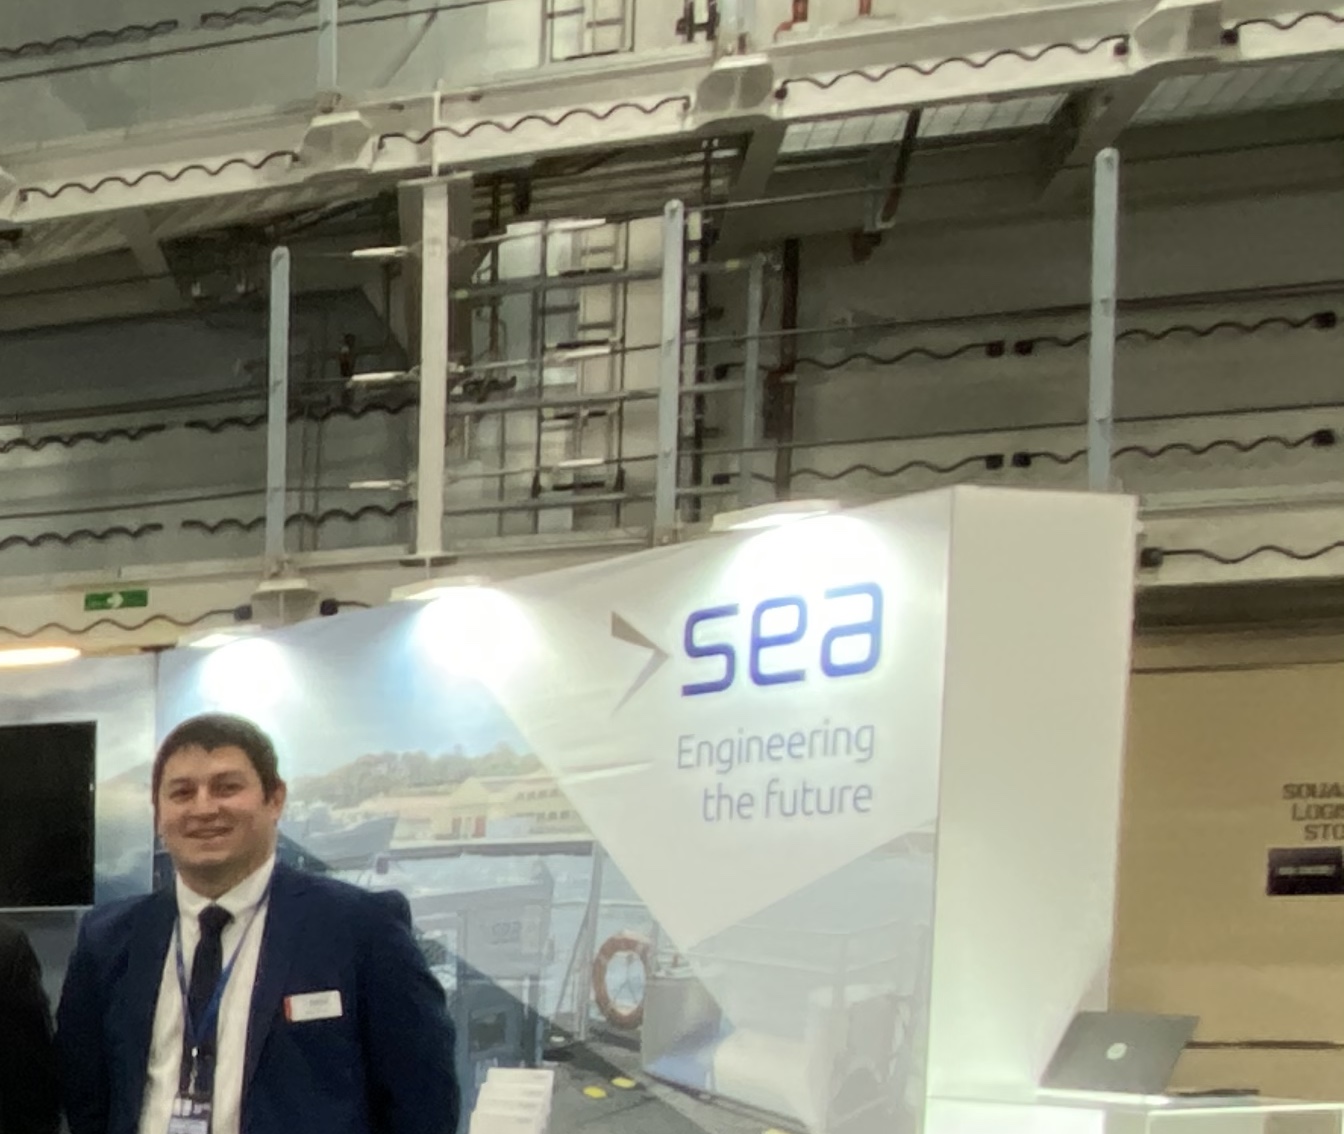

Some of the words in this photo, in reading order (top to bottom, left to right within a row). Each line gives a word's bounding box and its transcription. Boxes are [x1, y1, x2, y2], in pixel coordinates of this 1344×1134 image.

[681, 581, 884, 697] sea
[677, 718, 875, 775] Engineering
[702, 782, 755, 822] the
[765, 777, 873, 818] future
